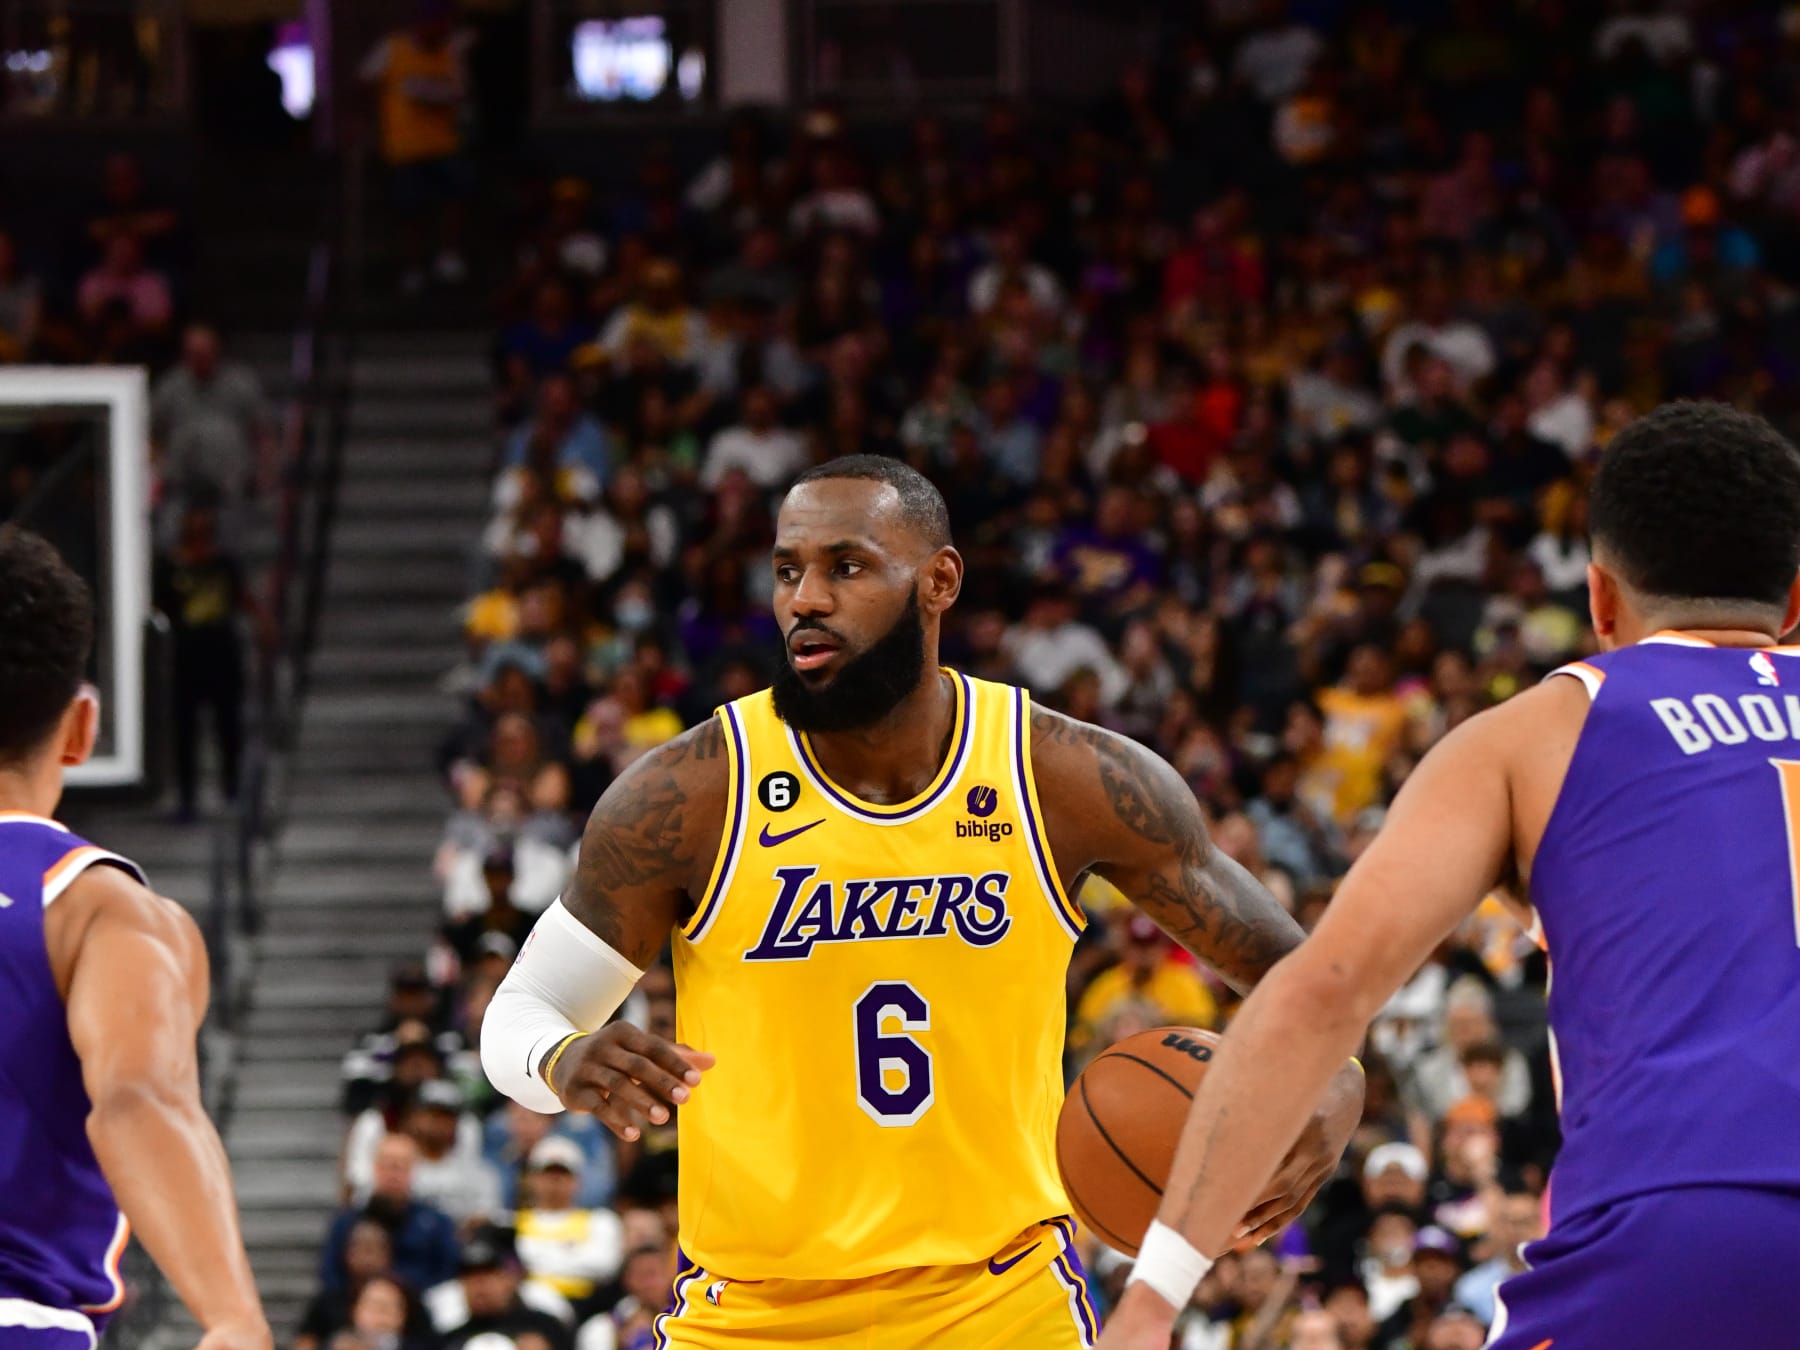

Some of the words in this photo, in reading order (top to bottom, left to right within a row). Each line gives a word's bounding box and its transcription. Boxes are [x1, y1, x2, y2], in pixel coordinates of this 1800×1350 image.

[769, 777, 790, 807] 6
[956, 820, 1013, 842] bibigo
[742, 864, 1013, 961] LAKERS
[852, 980, 934, 1127] 6
